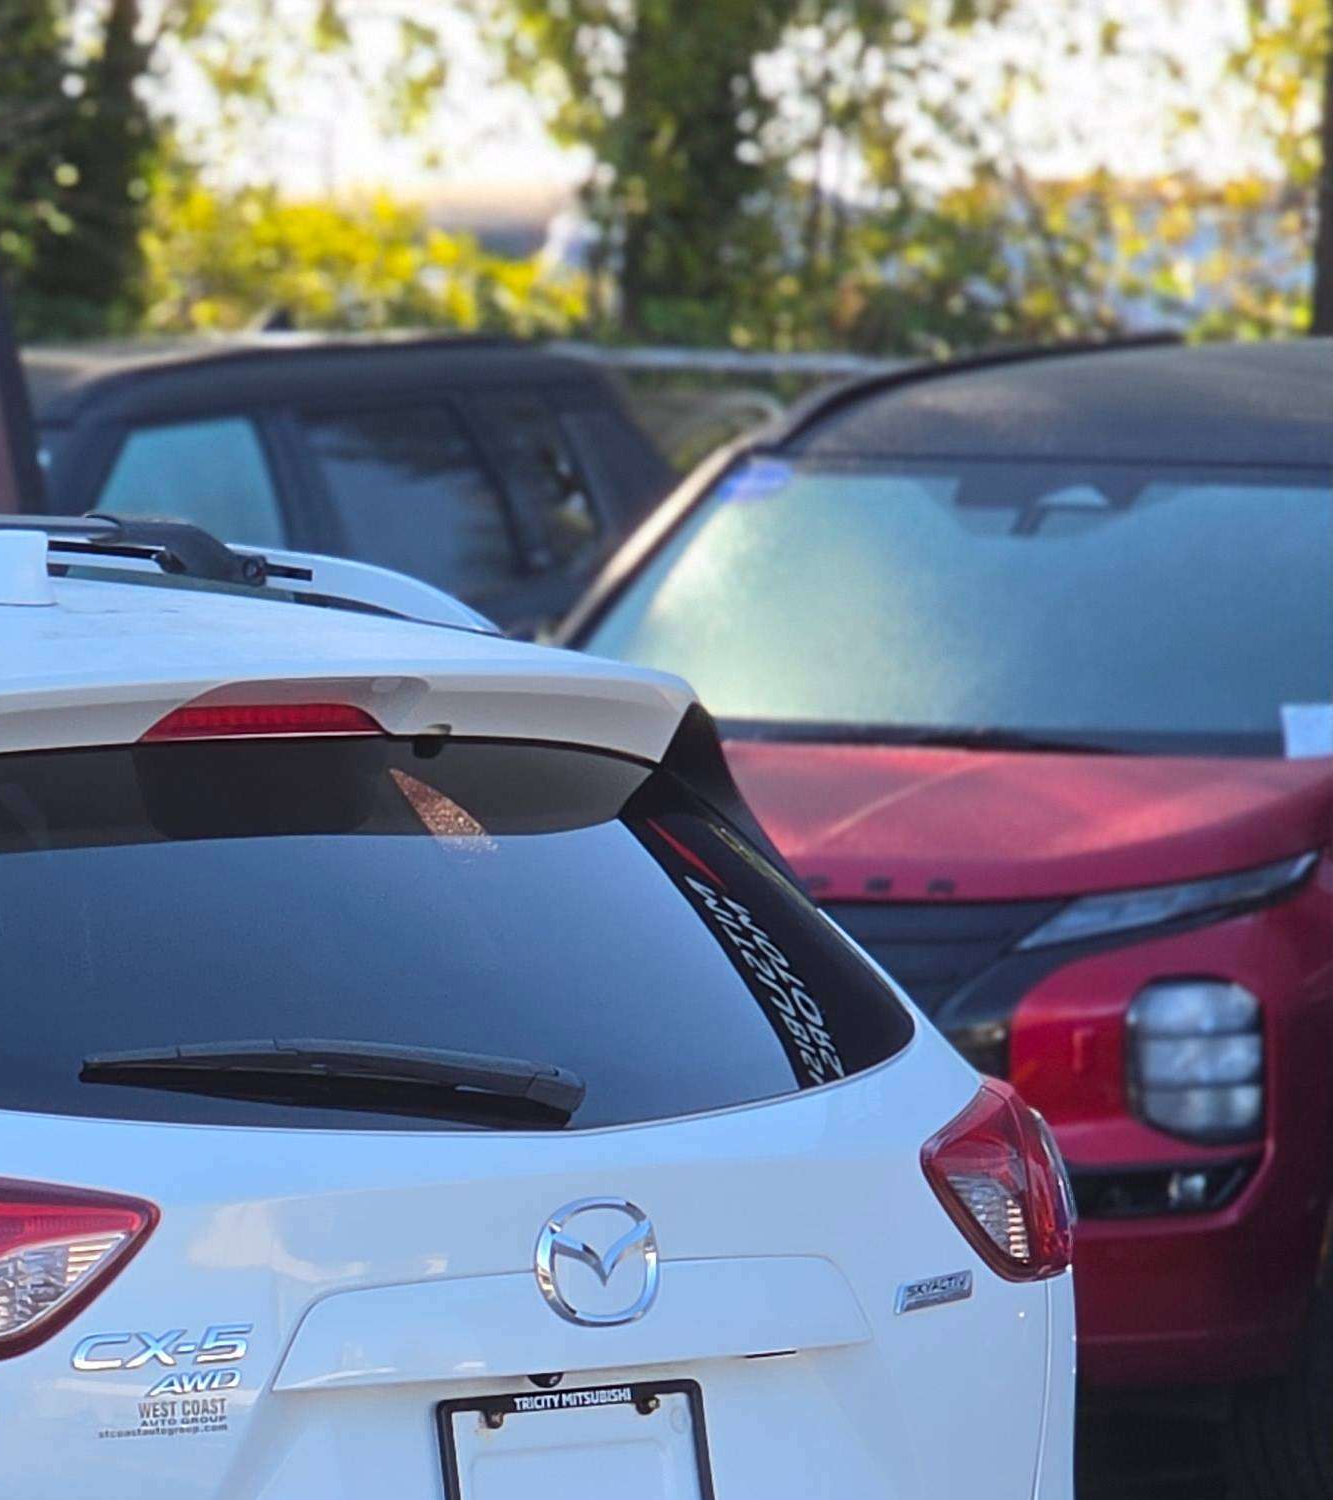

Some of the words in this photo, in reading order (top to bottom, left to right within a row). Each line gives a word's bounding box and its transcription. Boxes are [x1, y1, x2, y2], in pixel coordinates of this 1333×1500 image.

[70, 1323, 254, 1371] CX-5
[145, 1367, 242, 1397] AWD
[138, 1400, 176, 1419] WEST
[182, 1398, 226, 1416] COAST
[514, 1394, 560, 1411] TRICITY
[562, 1388, 631, 1407] MITSUBISHI
[140, 1417, 177, 1427] AUTO
[181, 1415, 226, 1425] GROUP
